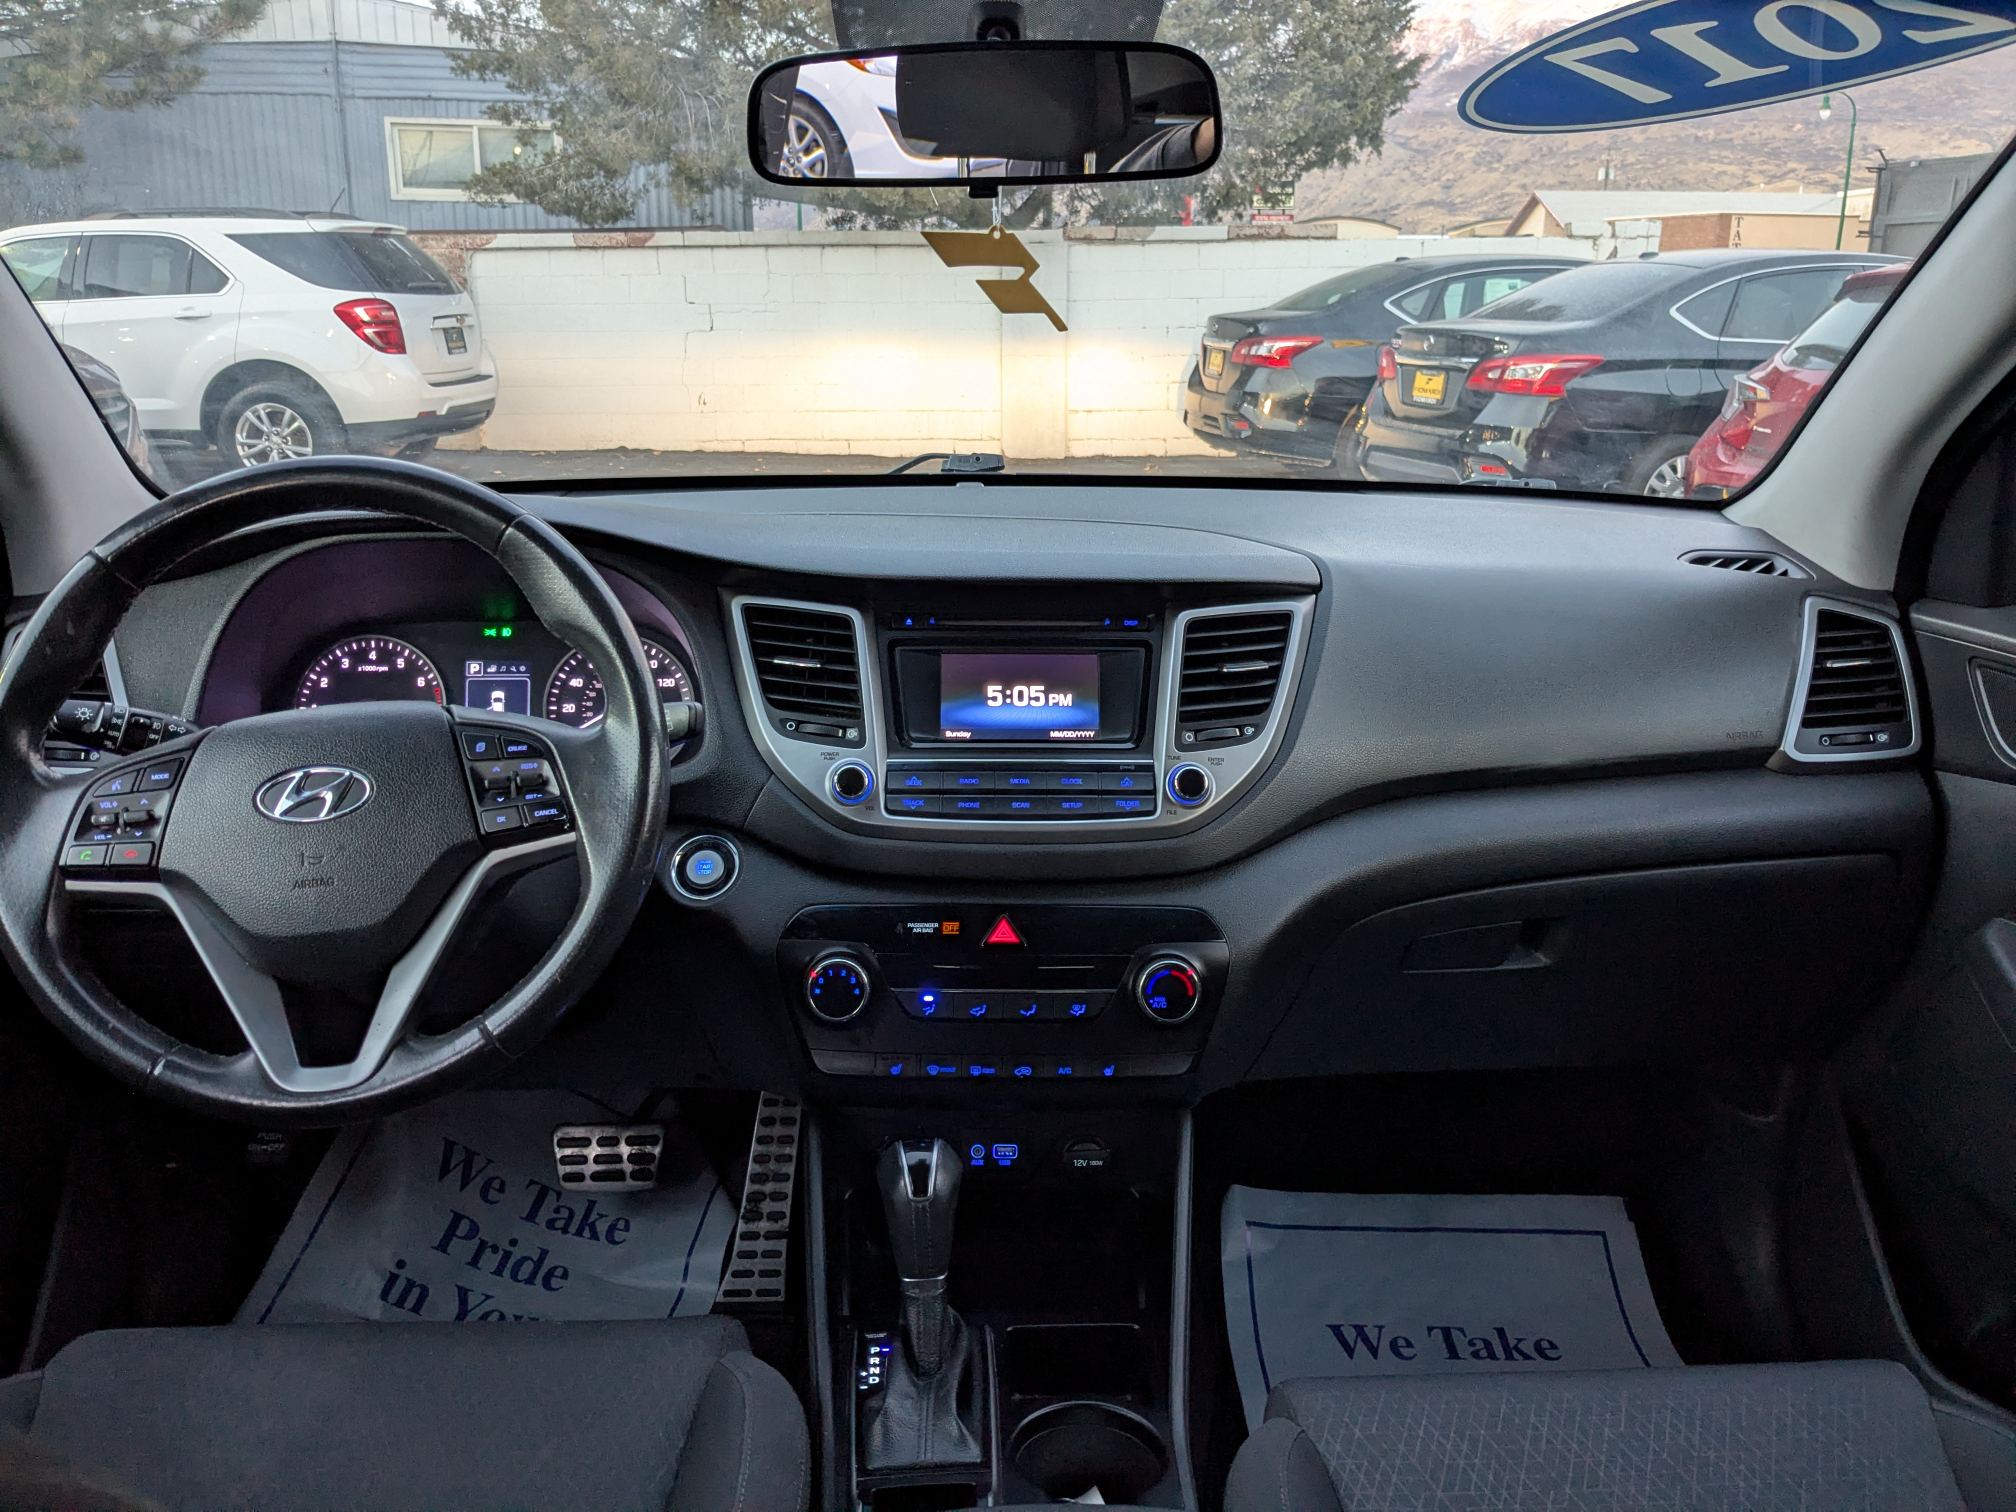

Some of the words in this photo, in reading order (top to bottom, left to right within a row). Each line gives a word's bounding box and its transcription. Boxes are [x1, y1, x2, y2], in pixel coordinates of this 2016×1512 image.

[368, 650, 377, 660] 4
[341, 658, 349, 669] 3
[397, 658, 405, 669] 5
[470, 663, 480, 674] P
[320, 677, 328, 688] 2
[417, 677, 425, 687] 6
[568, 678, 583, 688] 40
[657, 678, 675, 688] 120
[987, 685, 1046, 707] 5:05
[1048, 693, 1073, 707] PM
[562, 703, 576, 713] 20
[945, 730, 972, 739] Sunday
[534, 808, 559, 817] CANCEL
[292, 876, 335, 890] AIRBAG
[943, 924, 960, 932] OFF
[437, 1137, 507, 1206] We
[519, 1178, 632, 1246] Take
[431, 1209, 570, 1292] Pride
[380, 1258, 431, 1317] in
[1325, 1323, 1417, 1361] We
[1426, 1325, 1563, 1362] Take
[870, 1357, 880, 1365] R
[869, 1366, 880, 1374] N
